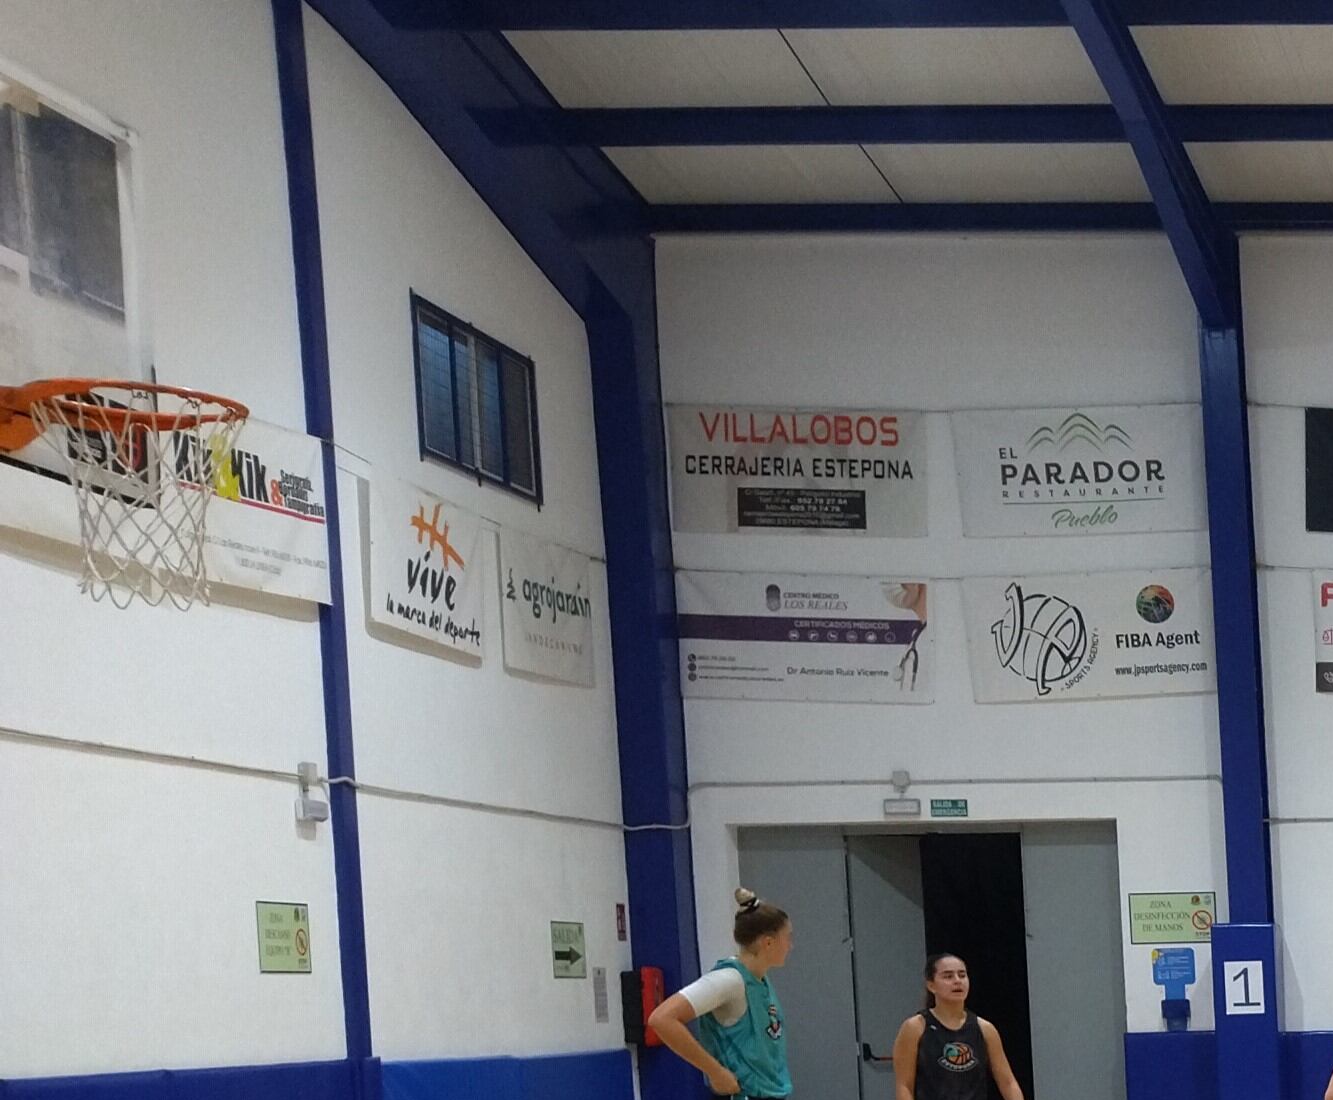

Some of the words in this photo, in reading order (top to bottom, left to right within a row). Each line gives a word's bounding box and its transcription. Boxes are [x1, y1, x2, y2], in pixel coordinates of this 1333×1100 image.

[699, 412, 899, 447] VILLALOBOS
[999, 447, 1018, 459] EL
[685, 455, 804, 477] CERRAJERIA
[812, 458, 914, 479] ESTEPONA
[1001, 459, 1165, 486] PARADOR
[1002, 485, 1164, 498] RESTAURANTE
[1051, 504, 1119, 528] Pueblo
[784, 601, 804, 609] LOS
[807, 600, 848, 610] REALES
[387, 593, 394, 615] la
[397, 604, 426, 626] marca
[429, 613, 442, 632] del
[444, 618, 480, 647] deporte
[1116, 633, 1152, 649] FIBA
[1155, 630, 1201, 649] Agent
[1065, 663, 1091, 690] SPORTS
[1087, 632, 1099, 665] AGENCY
[1115, 661, 1208, 676] www.jpsportsagency.com
[787, 666, 798, 675] Dr
[800, 667, 834, 676] Antonio
[857, 667, 889, 677] Vicente
[1150, 901, 1172, 909] ZONA
[1143, 924, 1151, 932] DE
[1155, 923, 1184, 931] MANOS
[1233, 967, 1261, 1006] 1
